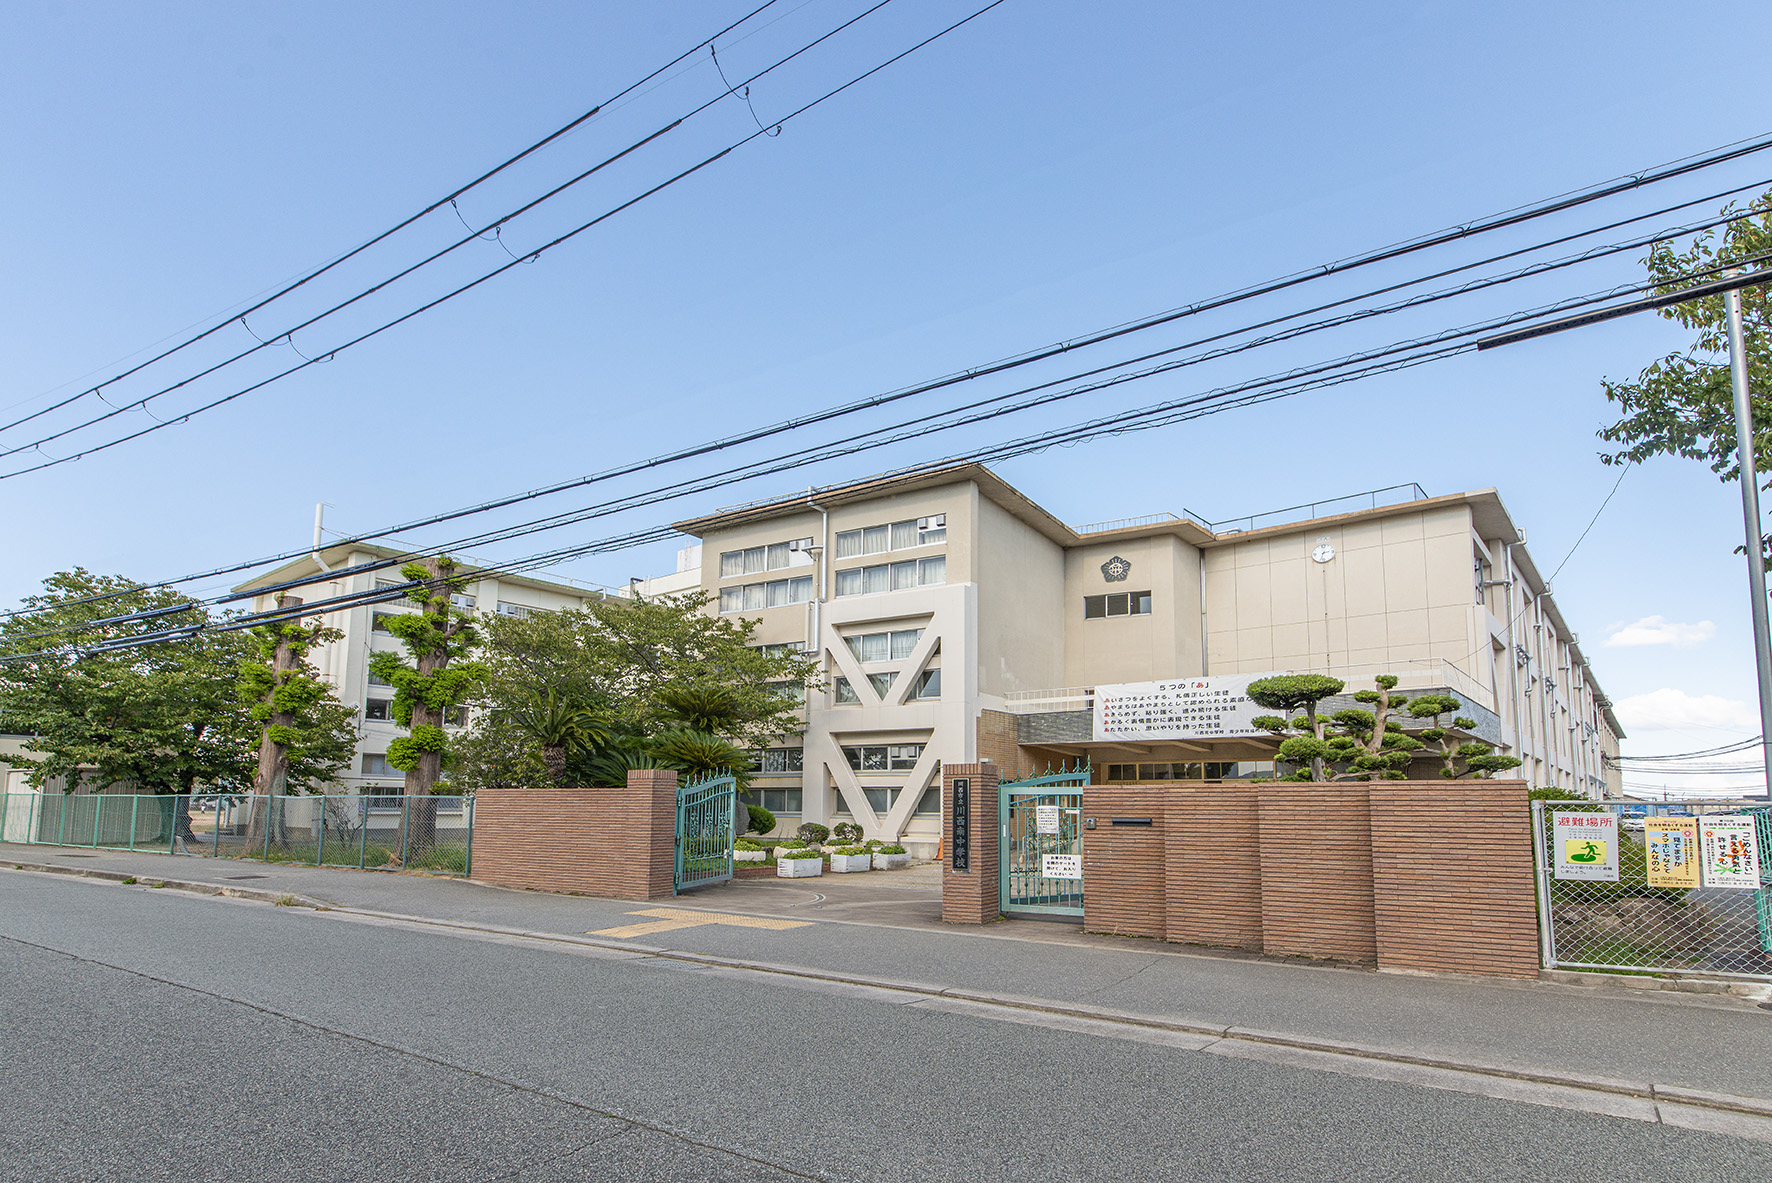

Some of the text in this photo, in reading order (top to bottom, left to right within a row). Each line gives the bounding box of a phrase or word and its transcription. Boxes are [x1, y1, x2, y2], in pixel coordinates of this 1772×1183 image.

[1558, 816, 1612, 827] 避難場所
[1651, 843, 1660, 872] みんなの心
